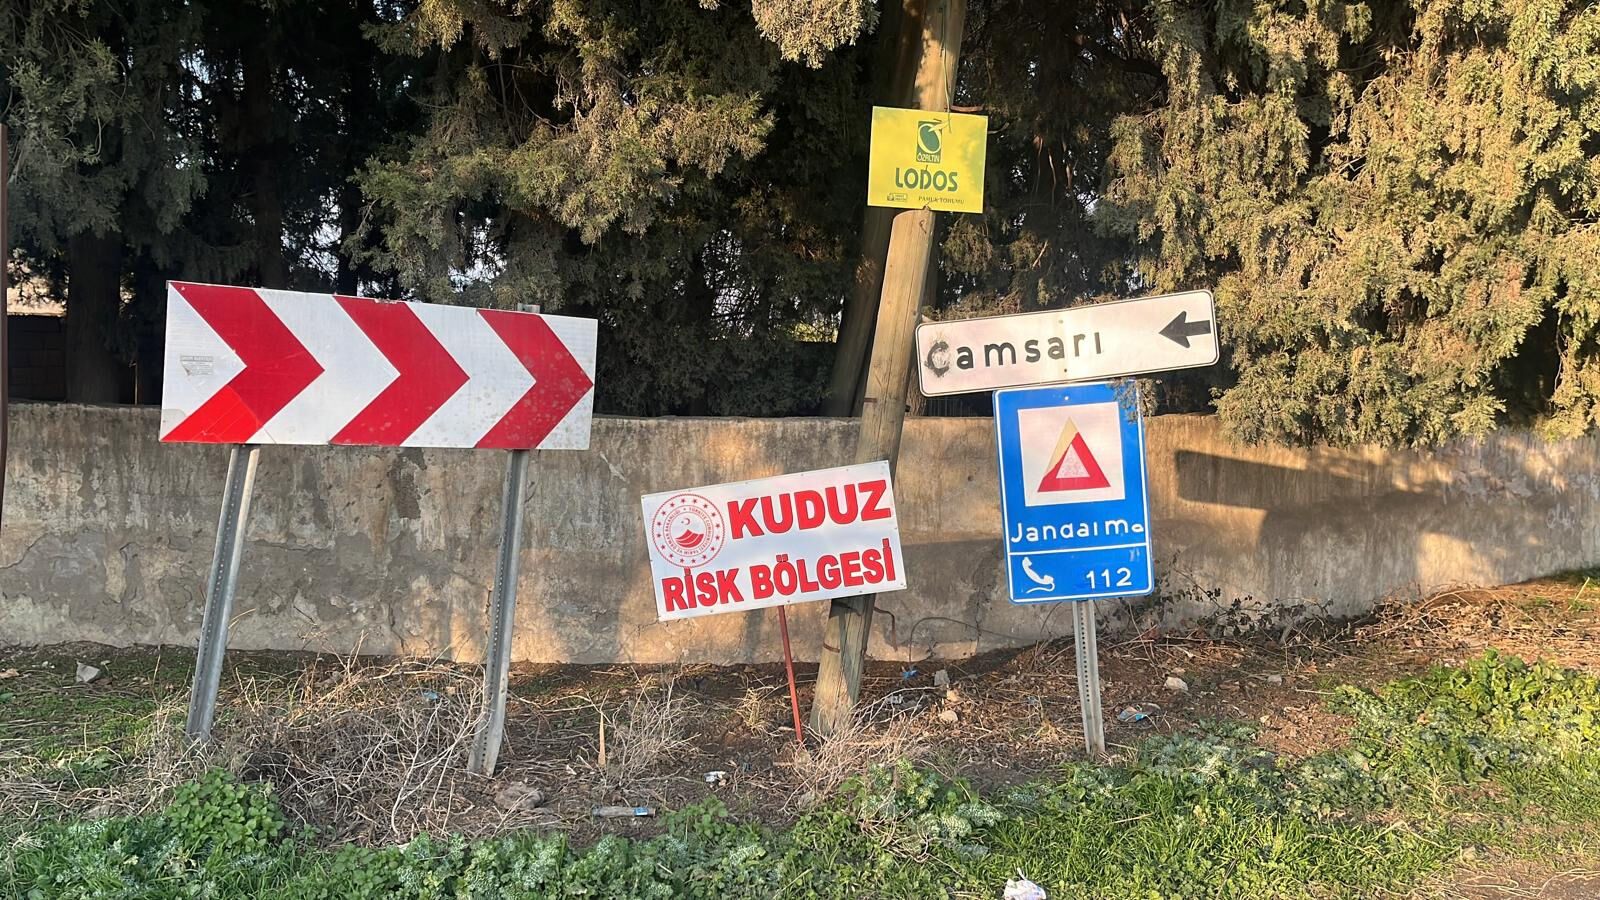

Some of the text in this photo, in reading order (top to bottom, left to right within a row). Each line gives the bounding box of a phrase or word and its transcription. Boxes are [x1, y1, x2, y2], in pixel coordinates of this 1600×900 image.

[895, 167, 958, 192] LODOS
[728, 480, 892, 540] KUDUZ
[662, 538, 896, 612] RİSK BÖLGESİ
[1086, 567, 1133, 589] 112
